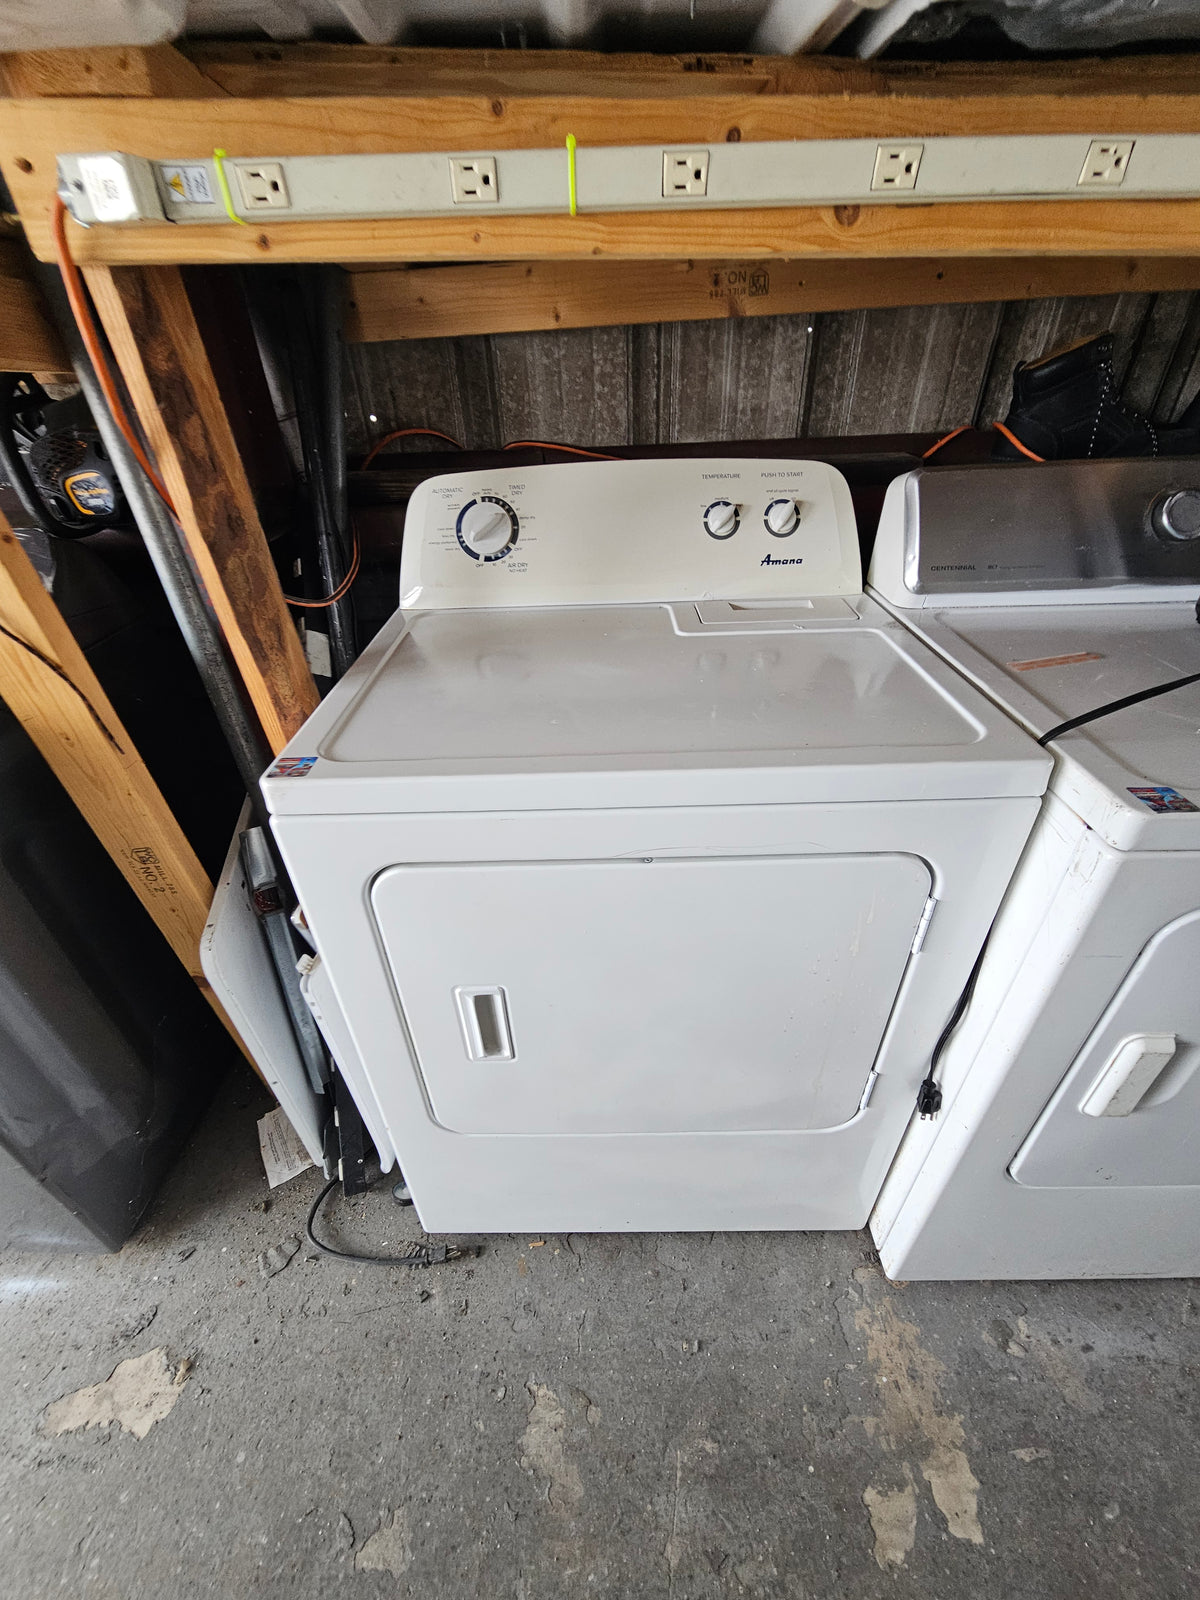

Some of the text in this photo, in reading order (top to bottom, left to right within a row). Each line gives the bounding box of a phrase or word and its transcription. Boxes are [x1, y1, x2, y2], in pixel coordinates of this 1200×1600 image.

[760, 554, 803, 566] Amana
[930, 564, 976, 572] CENTENNIAL
[139, 866, 166, 894] NO. 2
